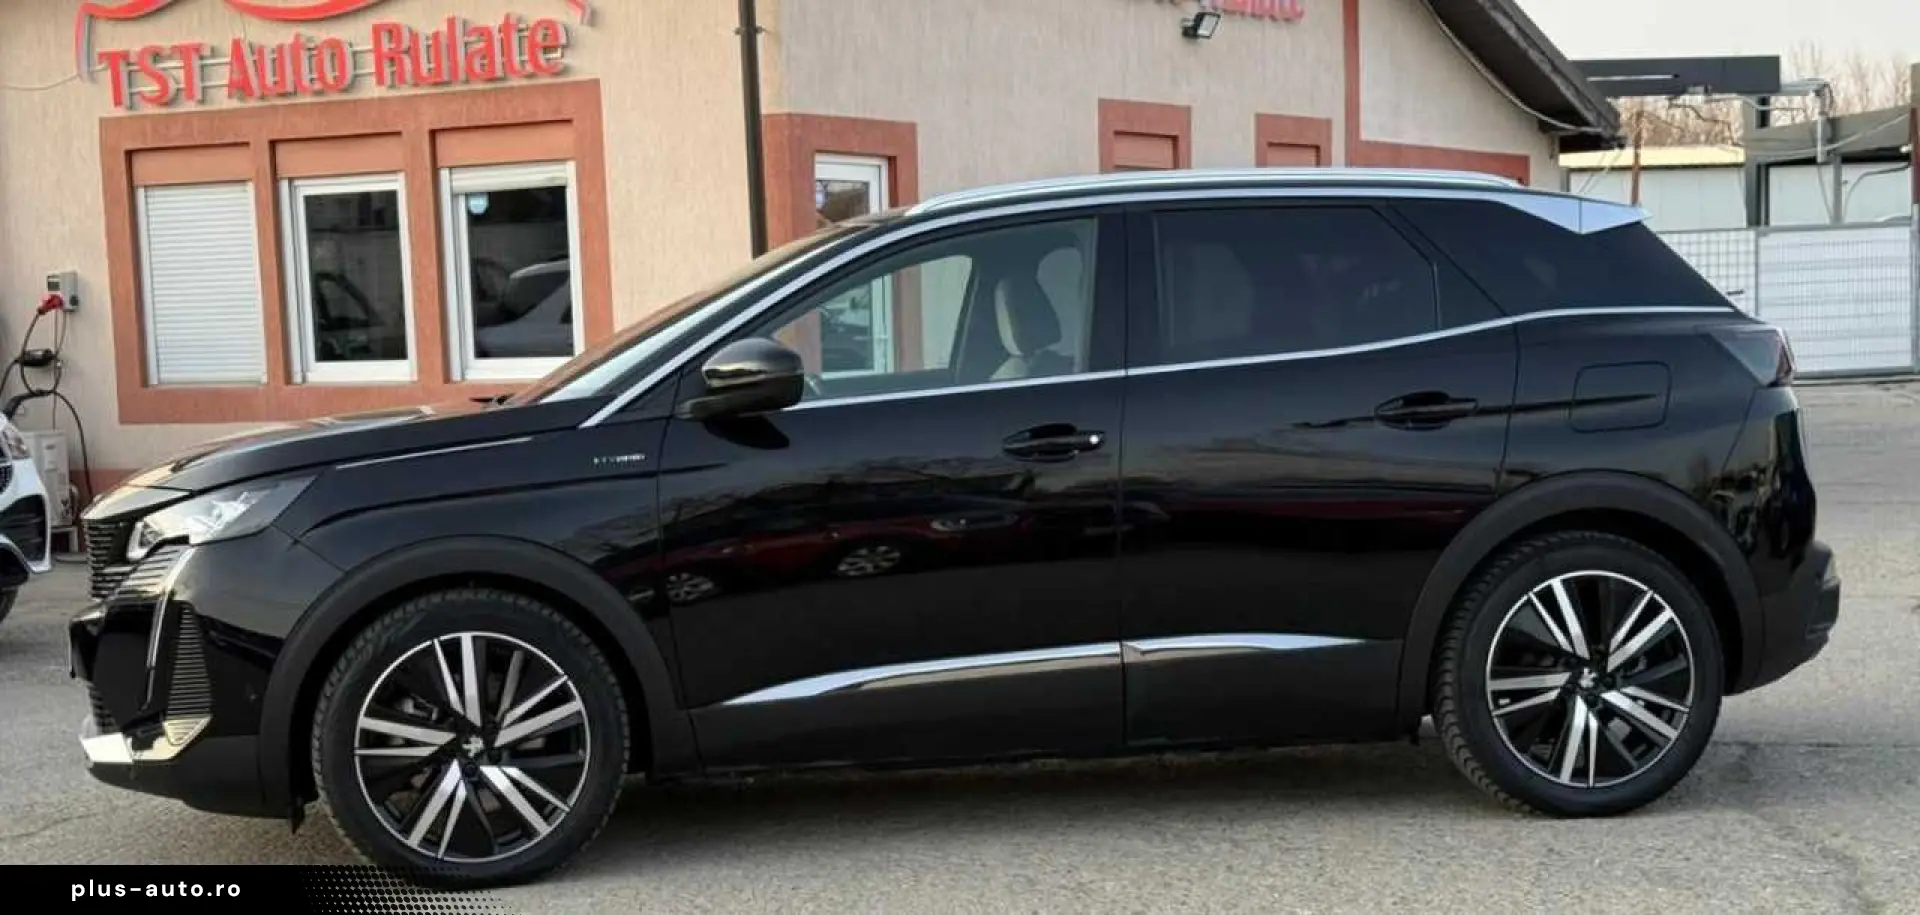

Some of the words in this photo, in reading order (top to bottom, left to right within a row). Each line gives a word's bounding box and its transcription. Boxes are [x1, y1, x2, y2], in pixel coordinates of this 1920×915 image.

[97, 42, 206, 108] TST
[227, 32, 350, 99] Auto
[371, 13, 567, 87] Rulate
